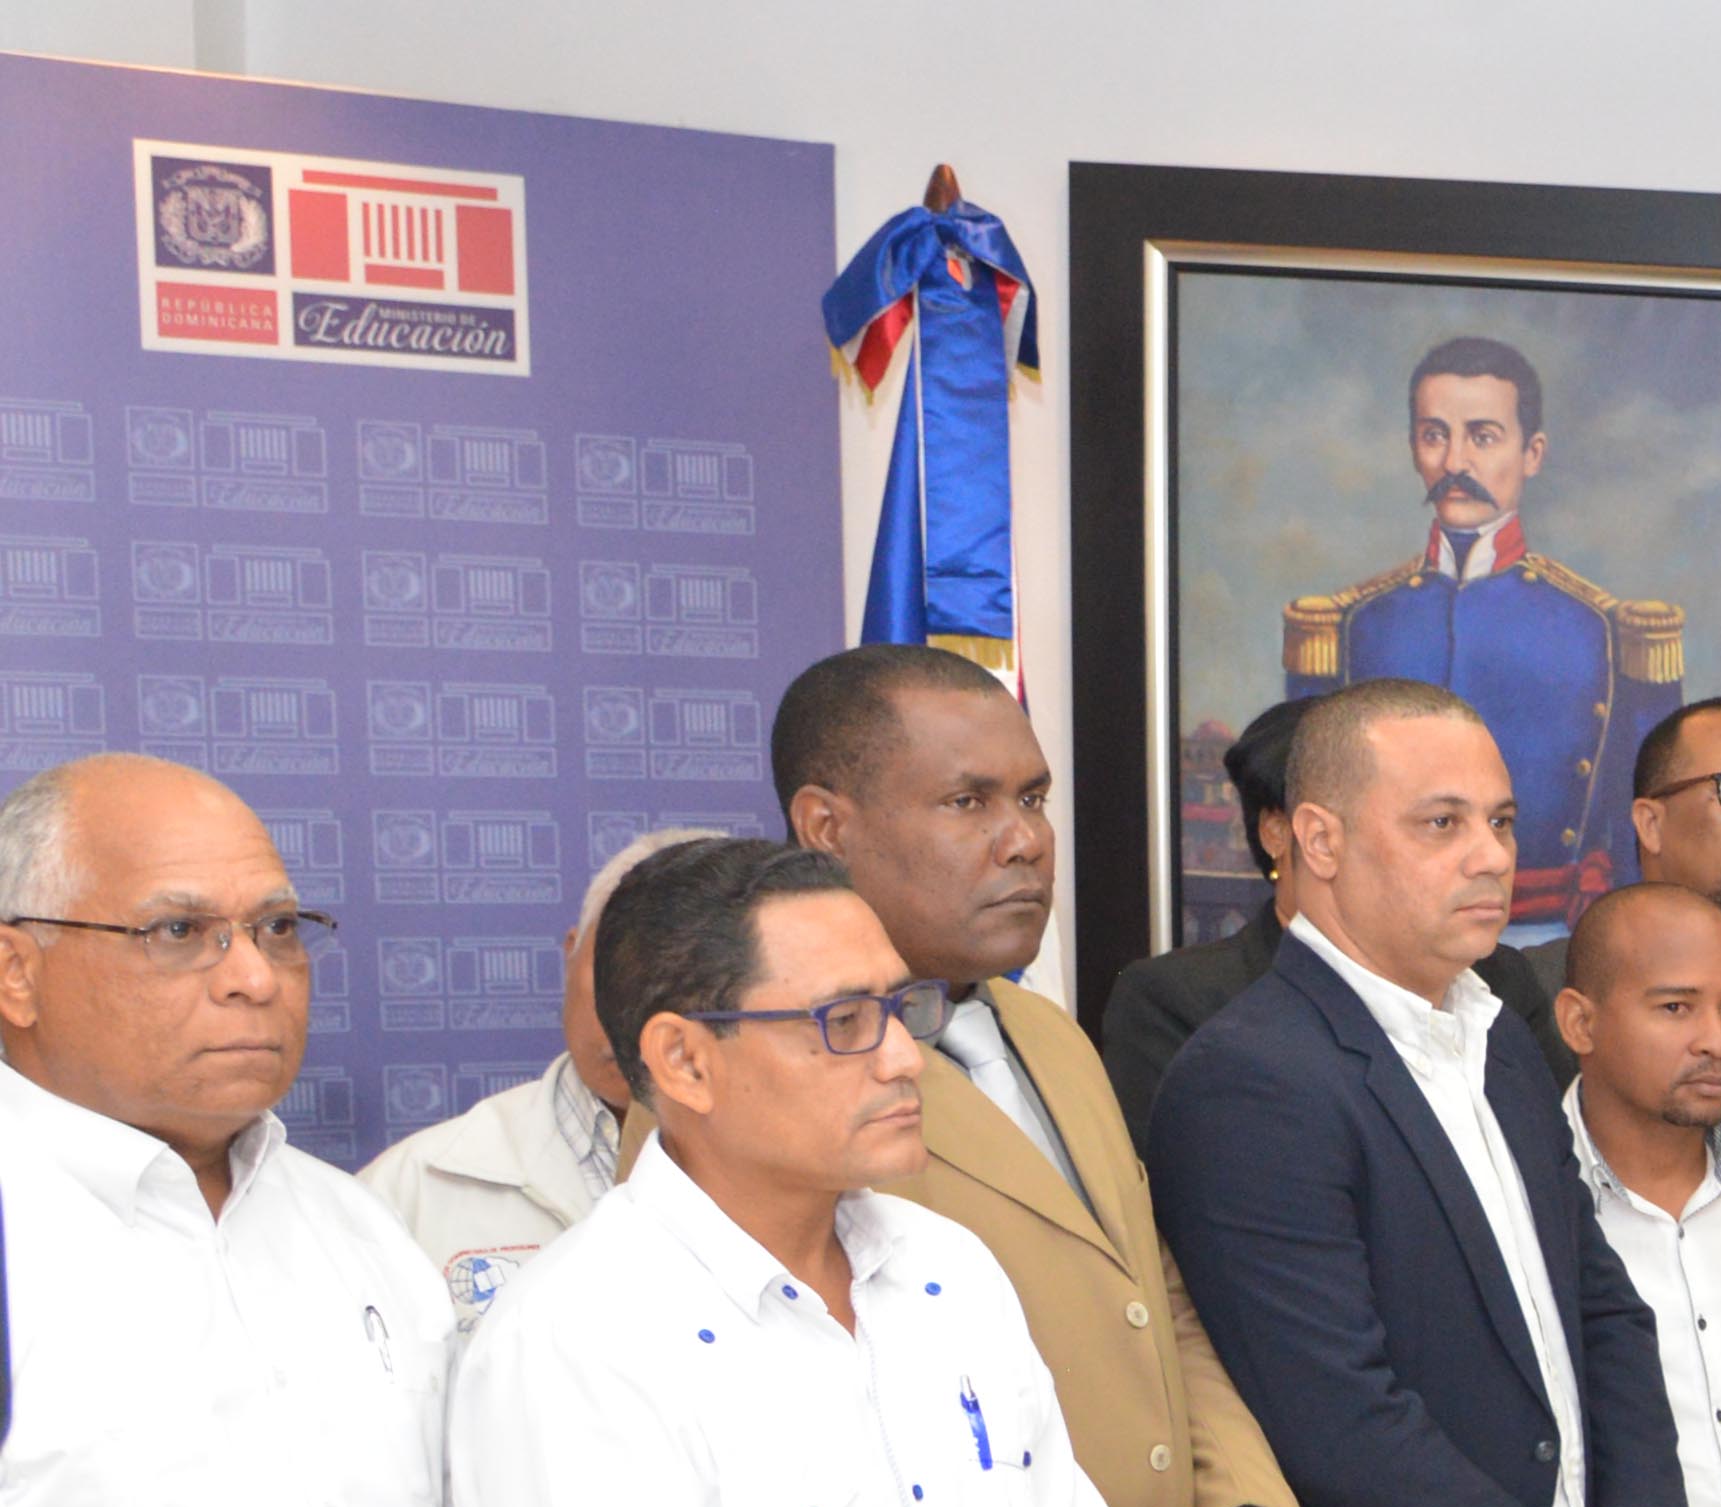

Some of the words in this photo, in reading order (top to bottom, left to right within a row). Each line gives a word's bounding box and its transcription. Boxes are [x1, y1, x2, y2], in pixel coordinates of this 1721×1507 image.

[160, 296, 273, 317] REPÚBLICA
[161, 312, 274, 332] DOMINICANA
[379, 308, 457, 325] MINISTERIO
[460, 313, 477, 326] DE
[299, 301, 509, 355] Educación
